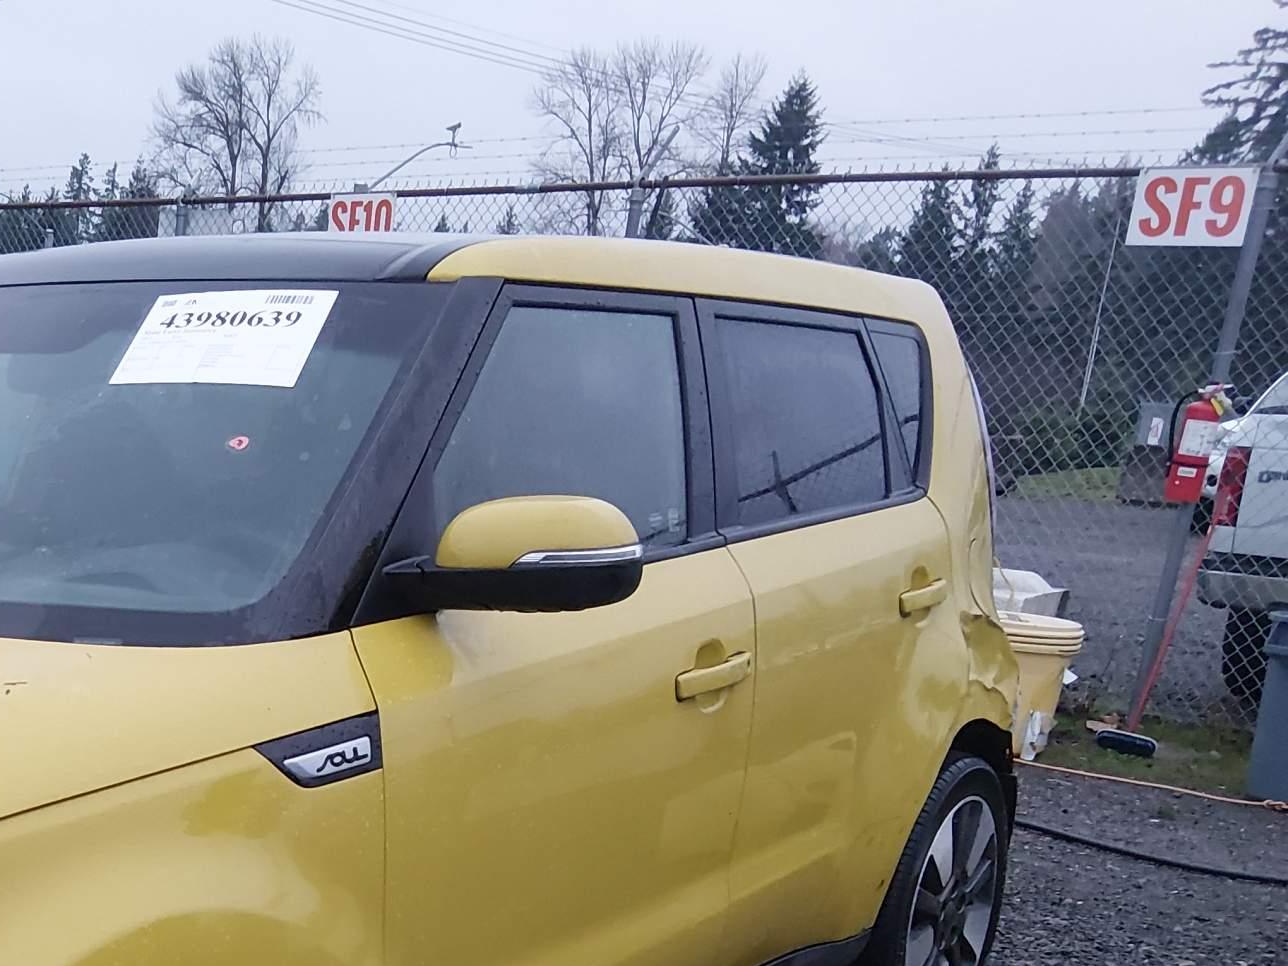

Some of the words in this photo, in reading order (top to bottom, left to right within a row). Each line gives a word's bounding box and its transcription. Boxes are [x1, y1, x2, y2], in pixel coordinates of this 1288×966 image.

[331, 199, 393, 232] SF10
[1138, 175, 1246, 238] SF9
[159, 310, 303, 329] 43980639
